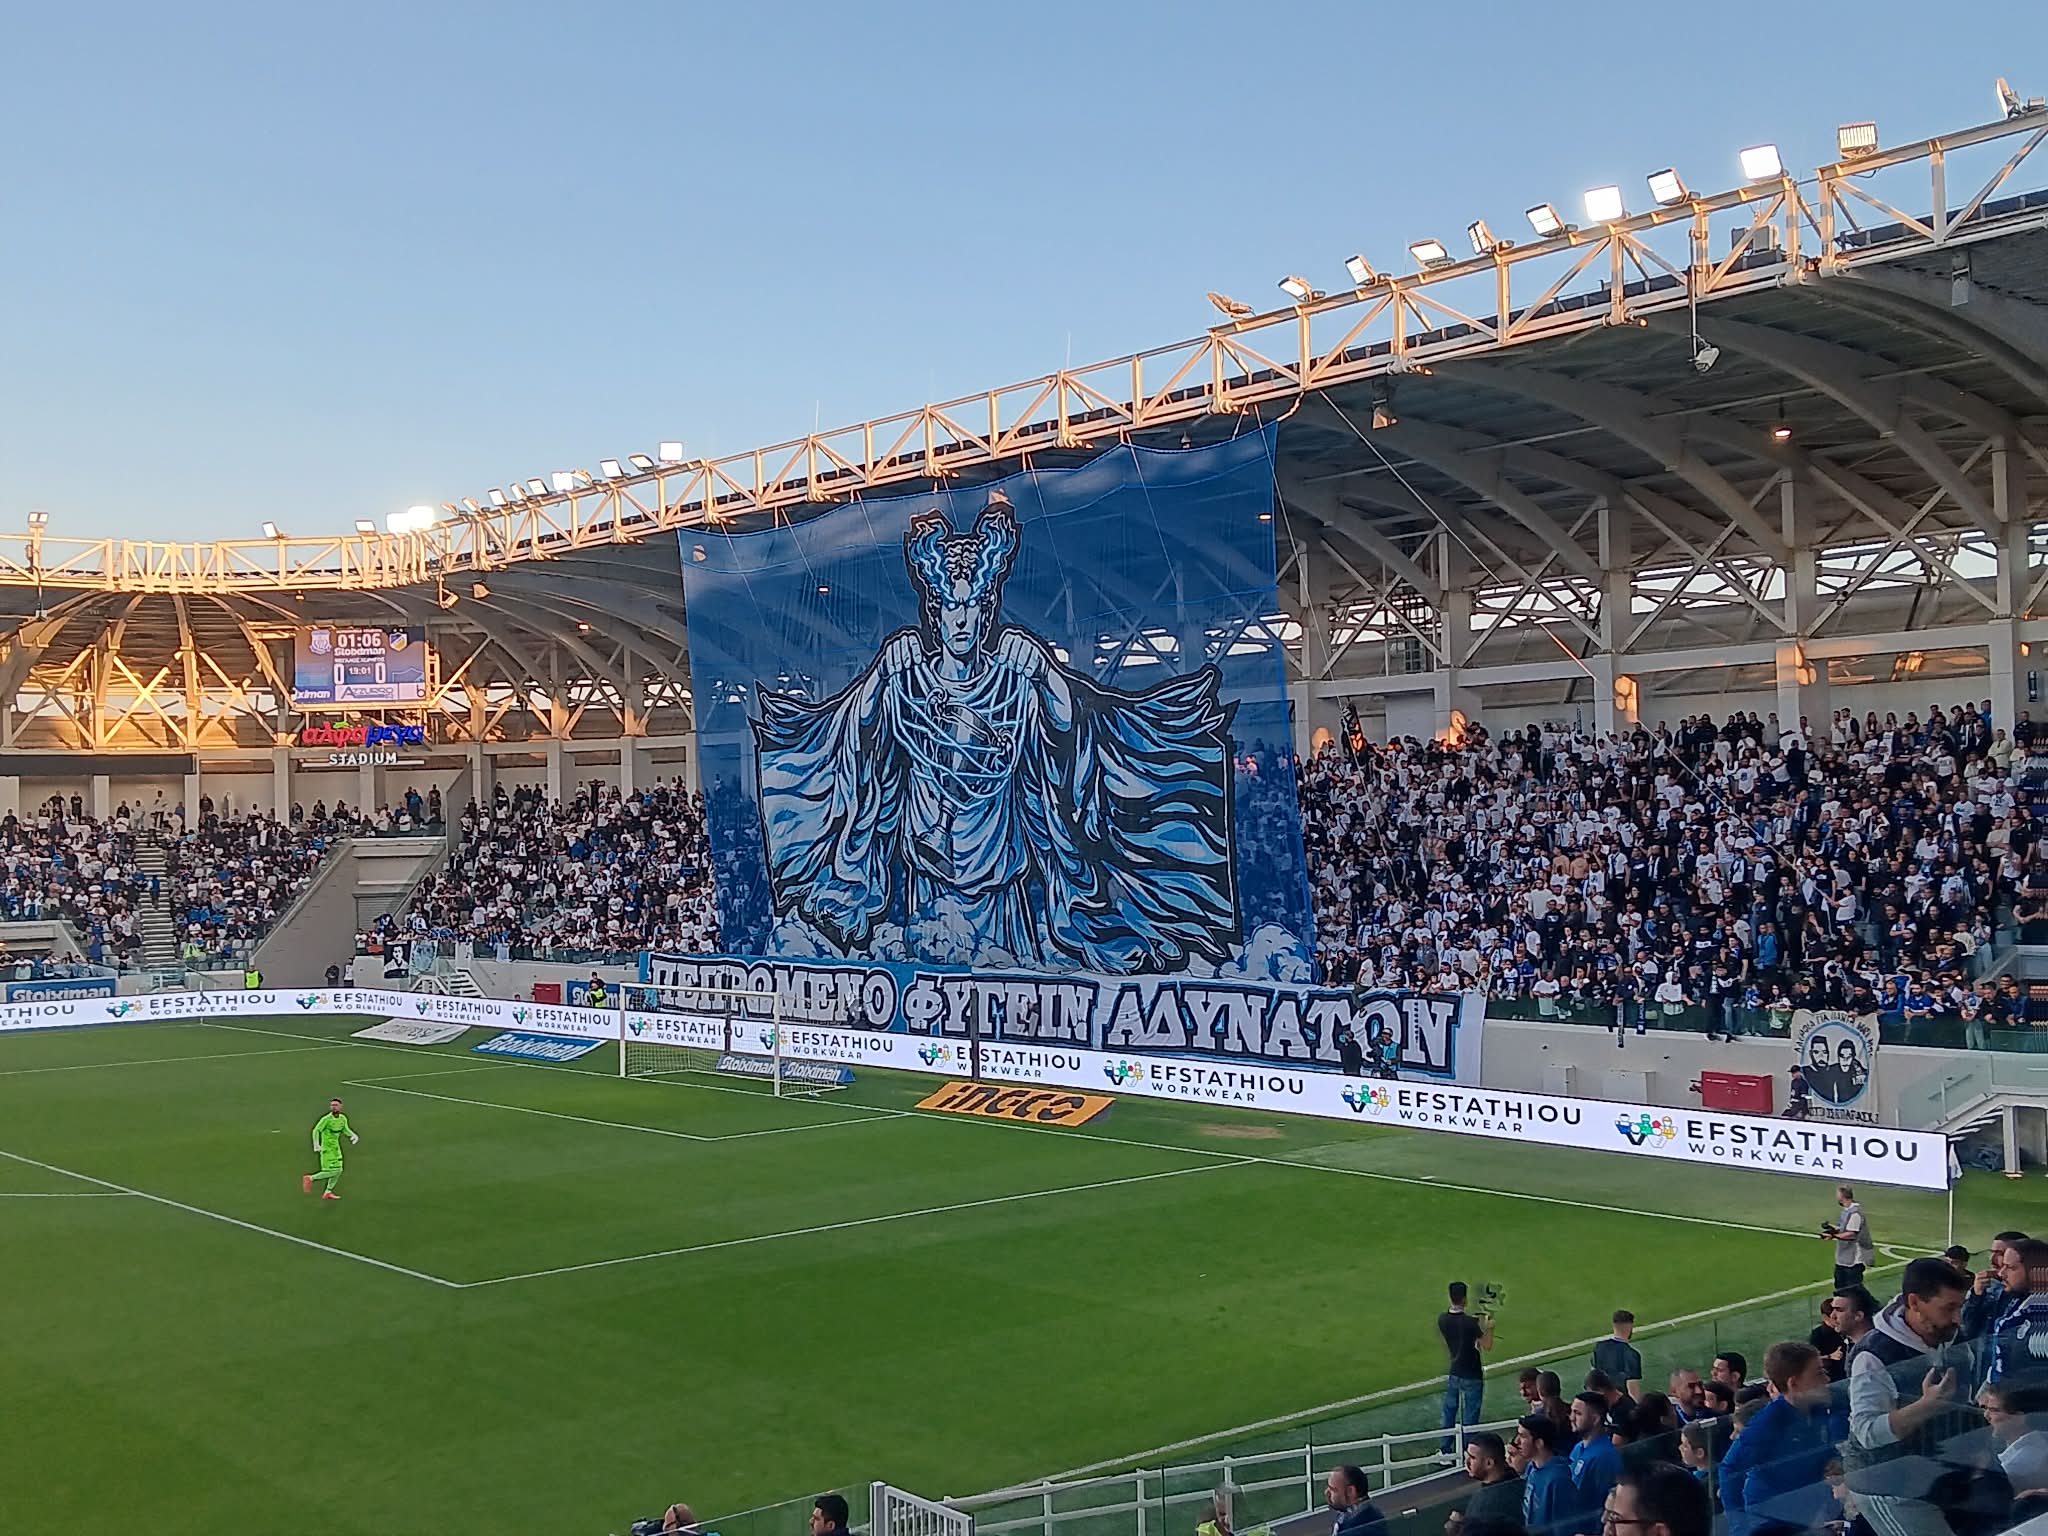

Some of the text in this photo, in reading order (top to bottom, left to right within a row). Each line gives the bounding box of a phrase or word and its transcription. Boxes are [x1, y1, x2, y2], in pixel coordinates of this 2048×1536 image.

[338, 633, 381, 647] 01:06
[334, 663, 345, 685] 0
[375, 662, 386, 684] 0
[329, 753, 398, 766] STADIUM
[12, 986, 111, 1002] Stoiximan
[150, 994, 277, 1010] EFSTATHIOU
[150, 1006, 239, 1016] WORKWEAR
[436, 1000, 502, 1015] EFSTATHIOU
[536, 1009, 611, 1026] EFSTATHIOU
[537, 1022, 588, 1032] WORKWEAR
[656, 1019, 743, 1039] EFSTATHIU
[904, 976, 1094, 1040] ΦΥΓΕΙΝ
[1106, 983, 1455, 1068] ΑΔΥΝΑΤΟΝ
[792, 1031, 893, 1053] EFSTATHIOU
[793, 1046, 862, 1060] WORKWEAR
[785, 1061, 841, 1081] Stoiximan
[958, 1062, 1042, 1078] WRKWEAR
[1151, 1063, 1304, 1096] EFSTATHIOU
[1152, 1082, 1256, 1103] WORKWEAR
[1399, 1089, 1581, 1126] EFSTATHIOU
[1400, 1109, 1523, 1134] WORKWEAR
[1687, 1119, 1919, 1163] EFSTATHIOU
[1689, 1142, 1844, 1171] WORKWEAR
